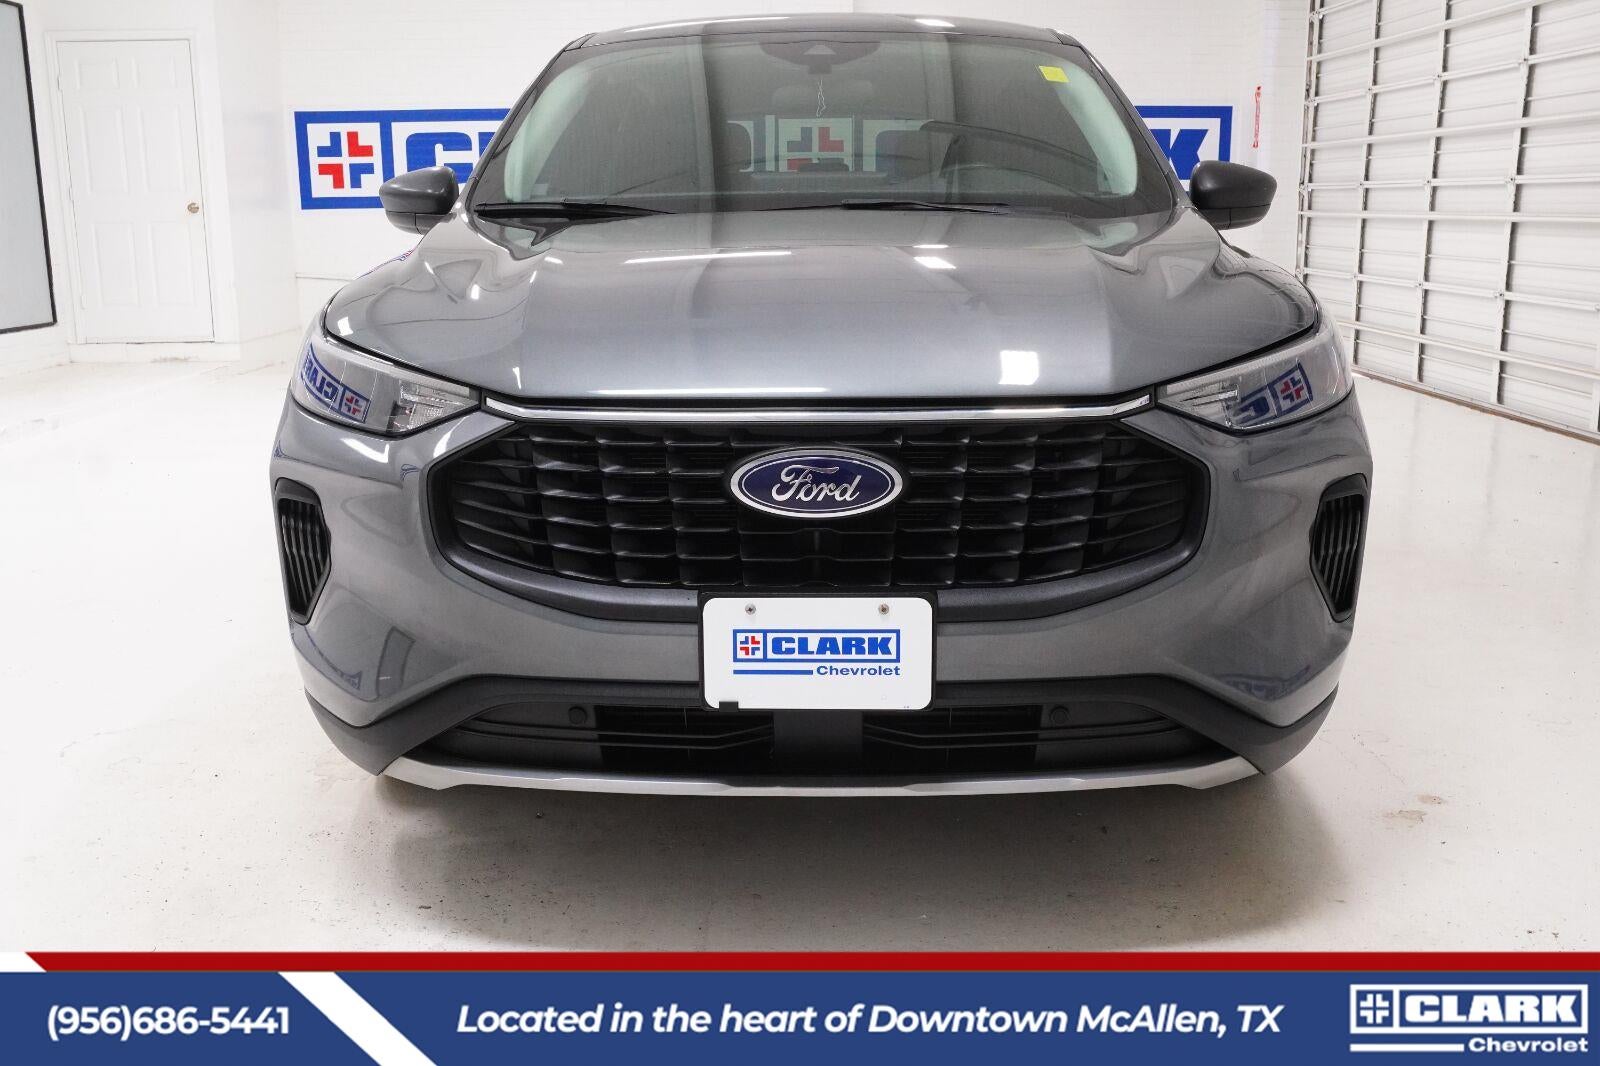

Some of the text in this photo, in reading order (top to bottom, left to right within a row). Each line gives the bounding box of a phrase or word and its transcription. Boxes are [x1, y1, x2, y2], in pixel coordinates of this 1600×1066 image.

[771, 464, 862, 502] Ford
[771, 636, 892, 655] CLARK
[816, 665, 900, 676] Chevrolet
